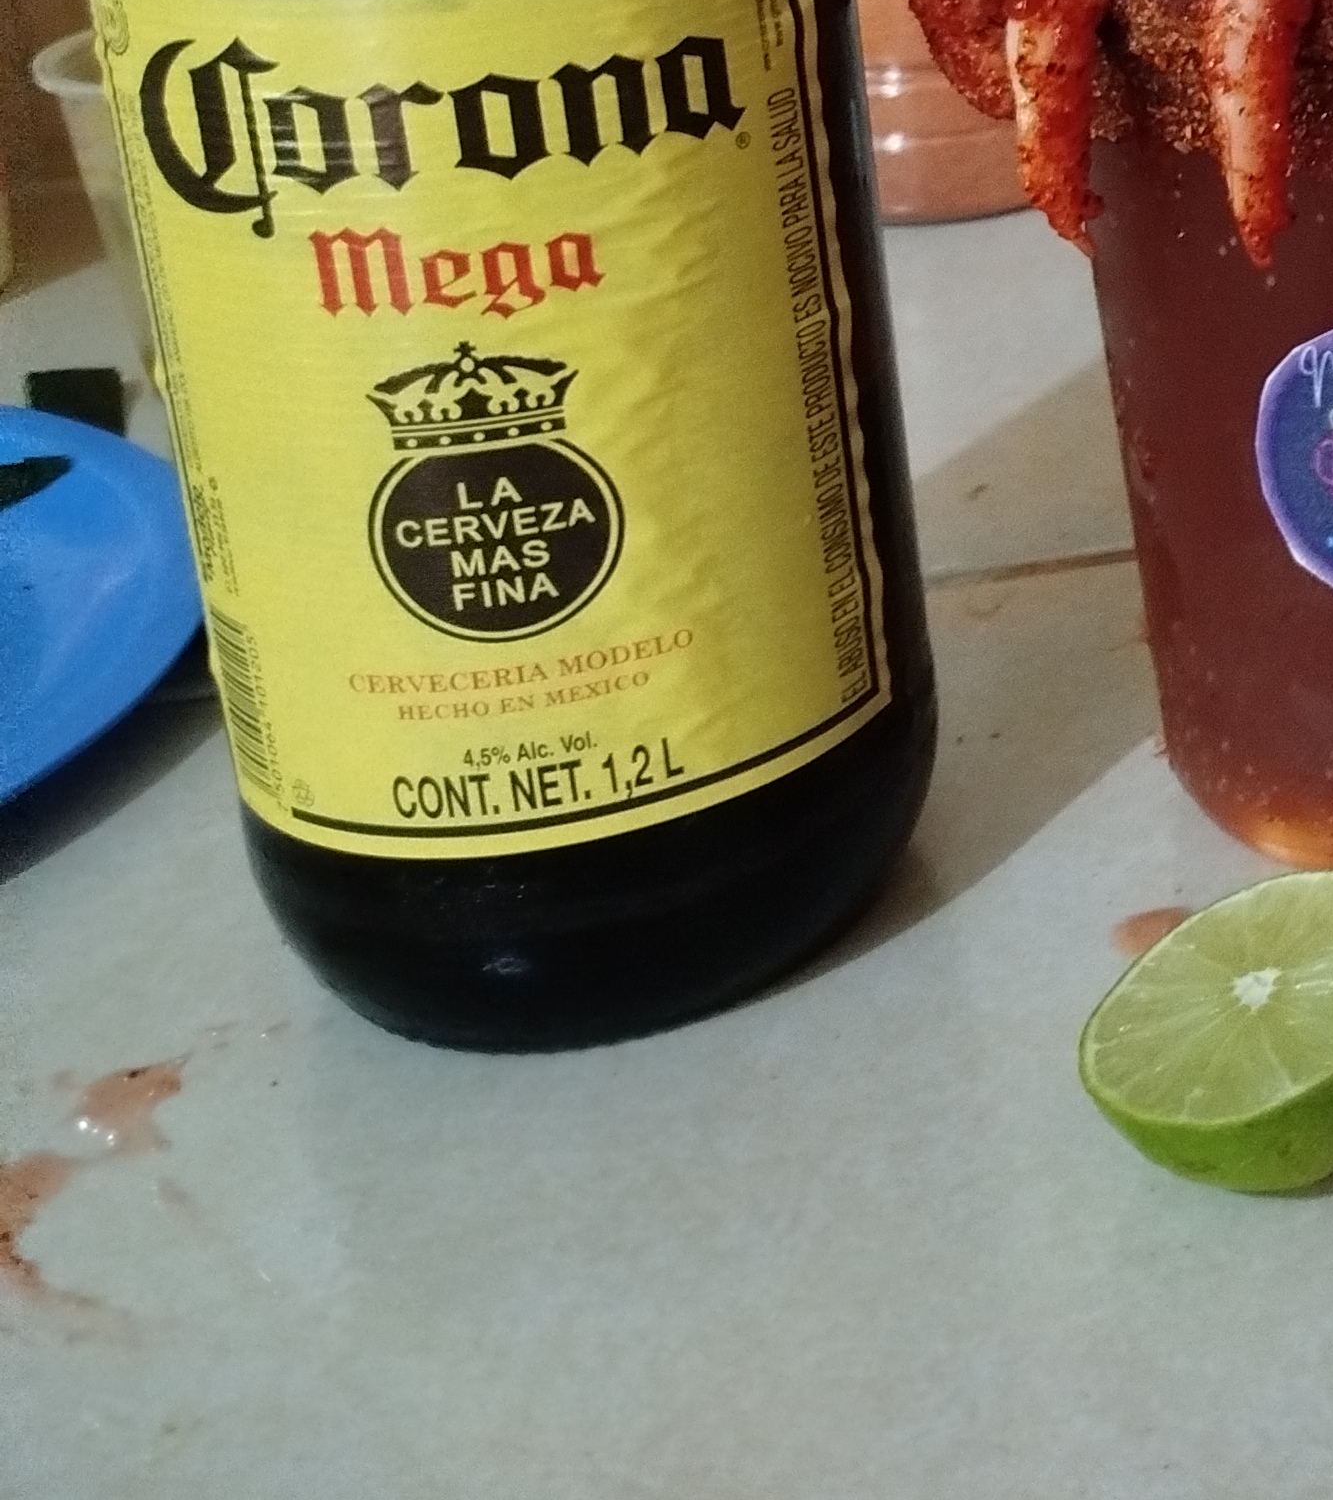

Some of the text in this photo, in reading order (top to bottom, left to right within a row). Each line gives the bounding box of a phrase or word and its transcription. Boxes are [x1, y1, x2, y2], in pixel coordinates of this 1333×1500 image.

[139, 34, 746, 238] Corona
[767, 87, 802, 150] SALUD
[776, 149, 804, 177] LA
[779, 175, 811, 226] PARA
[308, 227, 606, 319] Mega
[784, 225, 820, 296] NOCIVO
[794, 293, 822, 323] ES
[795, 319, 835, 417] PRODUCTO
[808, 411, 839, 460] ESTE
[457, 476, 522, 510] LA
[813, 461, 842, 488] DE
[396, 498, 596, 548] CERVEZA
[817, 483, 852, 572] CONSUMO
[450, 540, 550, 578] MAS
[452, 572, 560, 611] FINA
[348, 627, 694, 695] CERVECERIA MODELO
[834, 615, 864, 674] ABUSO
[398, 670, 650, 721] HECHO EN MEXICO
[463, 730, 598, 770] 4,5% Alc. Vol.
[392, 737, 685, 820] CONT. NET. 1,2 L
